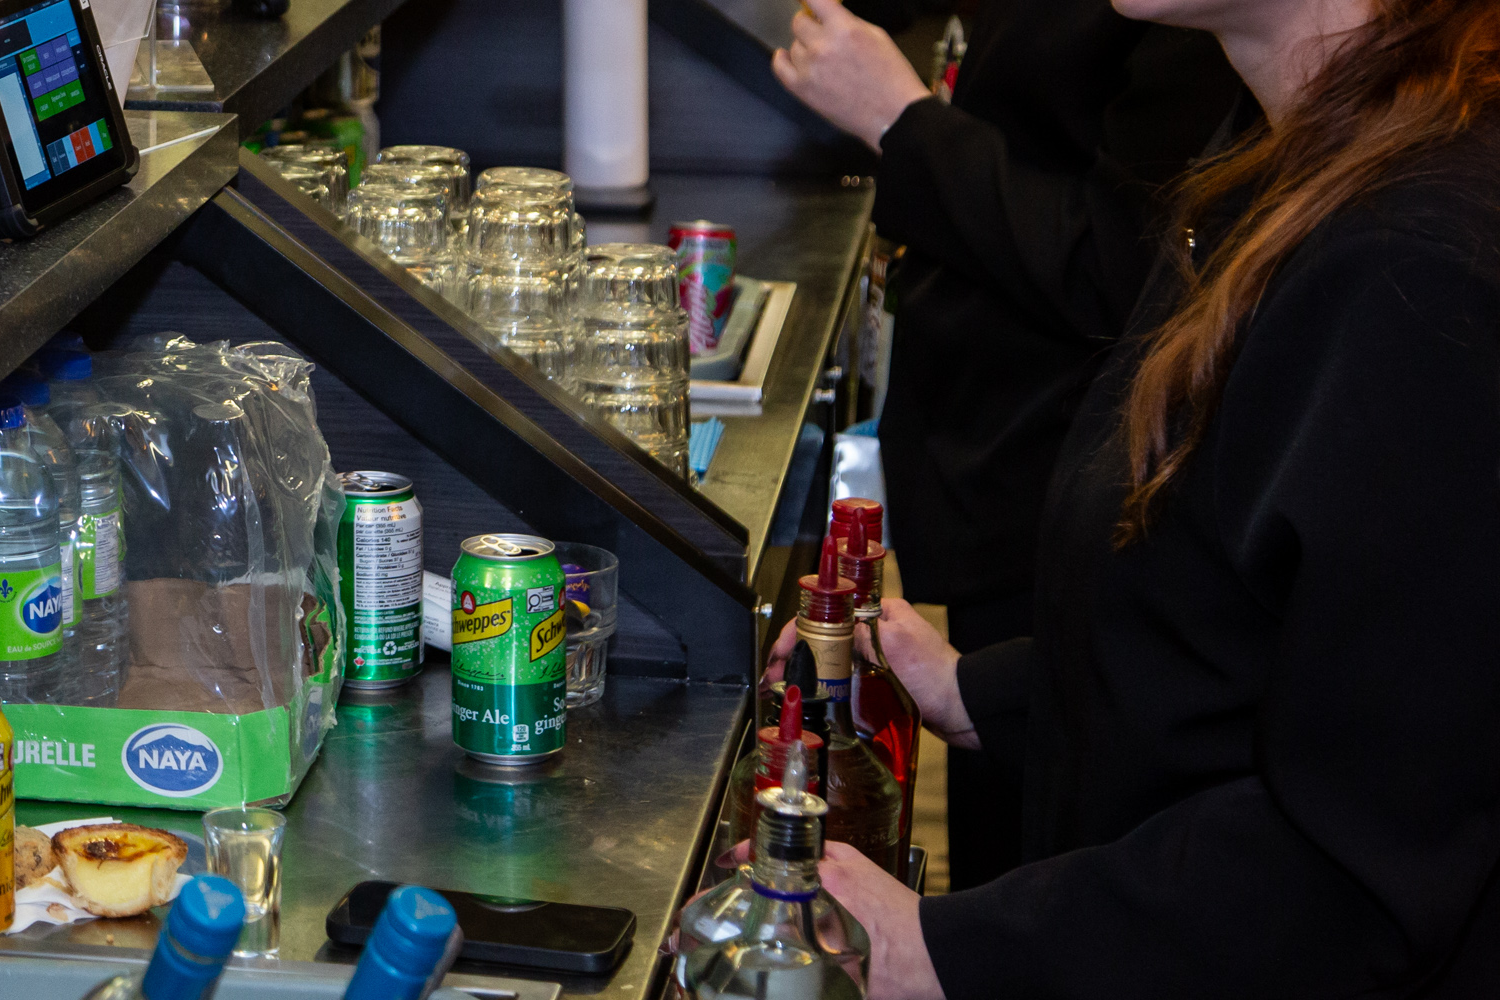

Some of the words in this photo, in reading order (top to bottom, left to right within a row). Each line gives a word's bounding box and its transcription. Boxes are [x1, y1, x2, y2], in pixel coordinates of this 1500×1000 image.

[96, 44, 113, 90] ORACLE
[7, 645, 23, 653] EAU
[816, 681, 850, 700] Morga
[482, 709, 510, 725] Ale
[139, 749, 208, 771] NAYA
